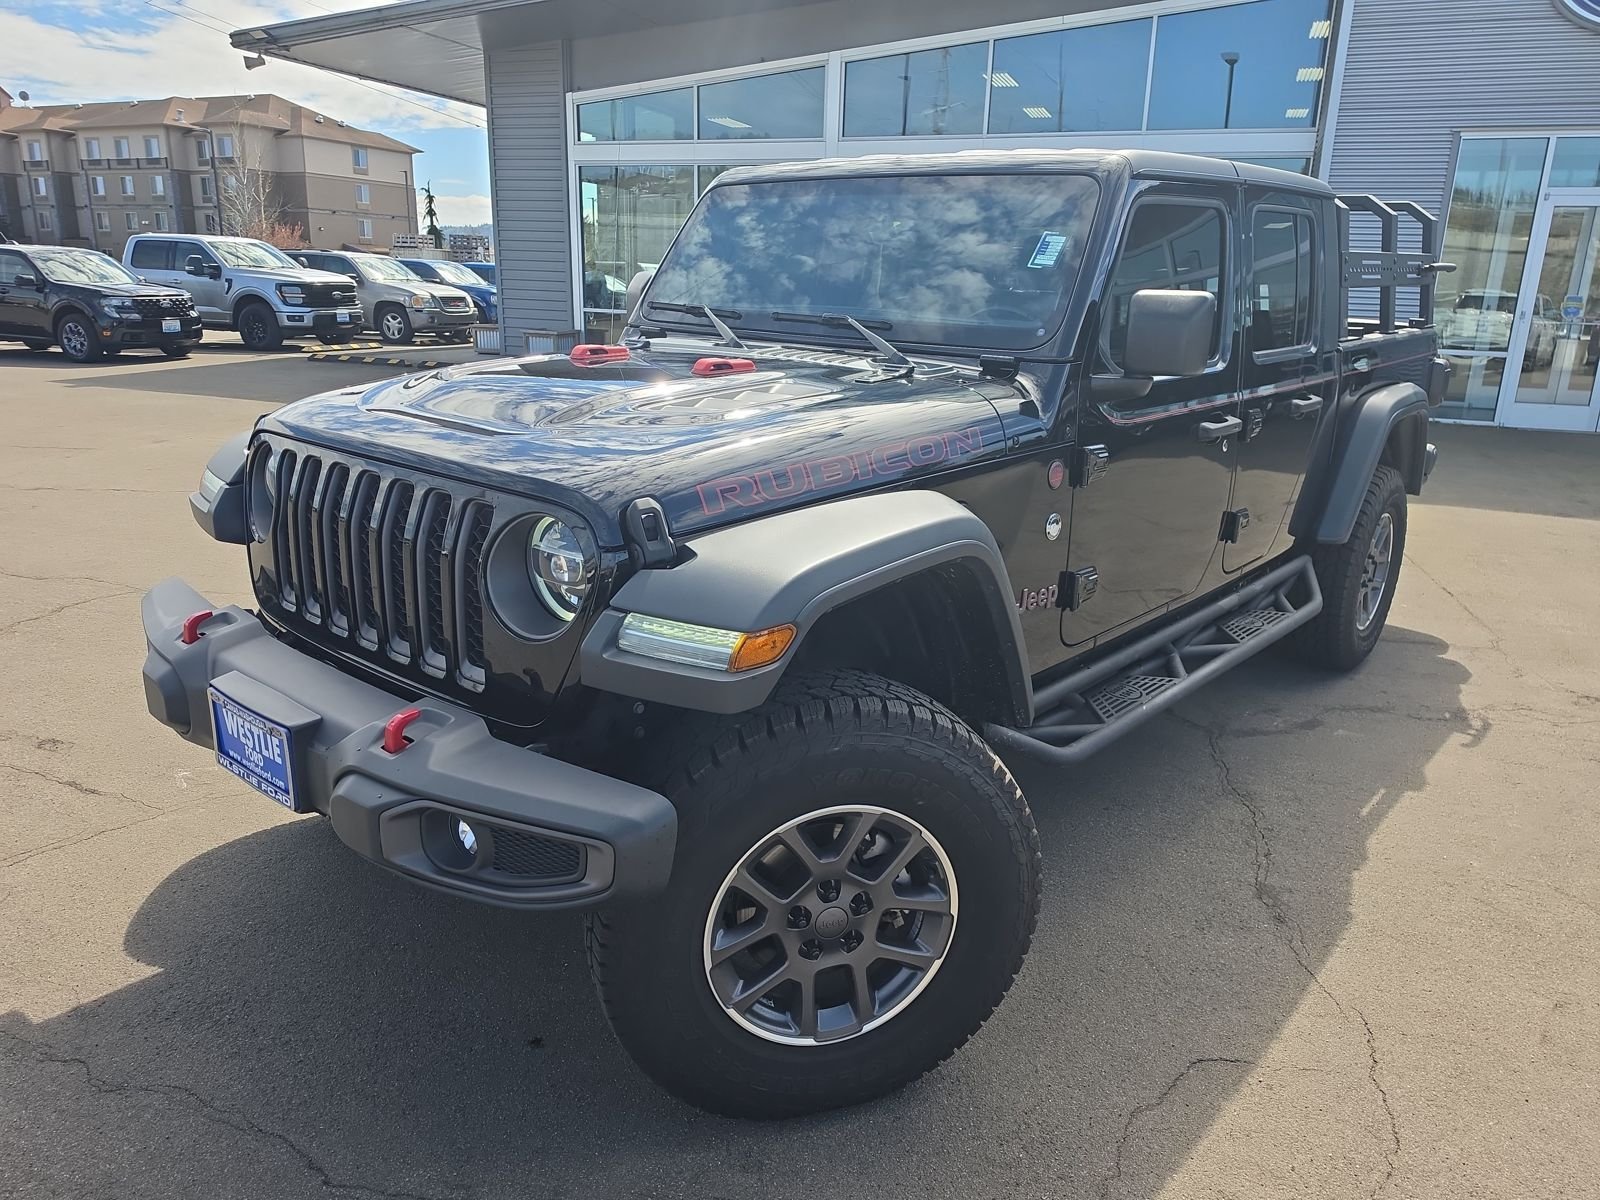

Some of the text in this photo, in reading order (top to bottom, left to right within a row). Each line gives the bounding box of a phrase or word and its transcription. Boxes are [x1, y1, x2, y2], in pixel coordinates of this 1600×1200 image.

[696, 427, 984, 515] RUBICON
[1016, 584, 1059, 614] Jeep
[222, 708, 283, 765] WESTLIE
[244, 744, 264, 767] FORD
[218, 755, 291, 807] WESTLIE FORD
